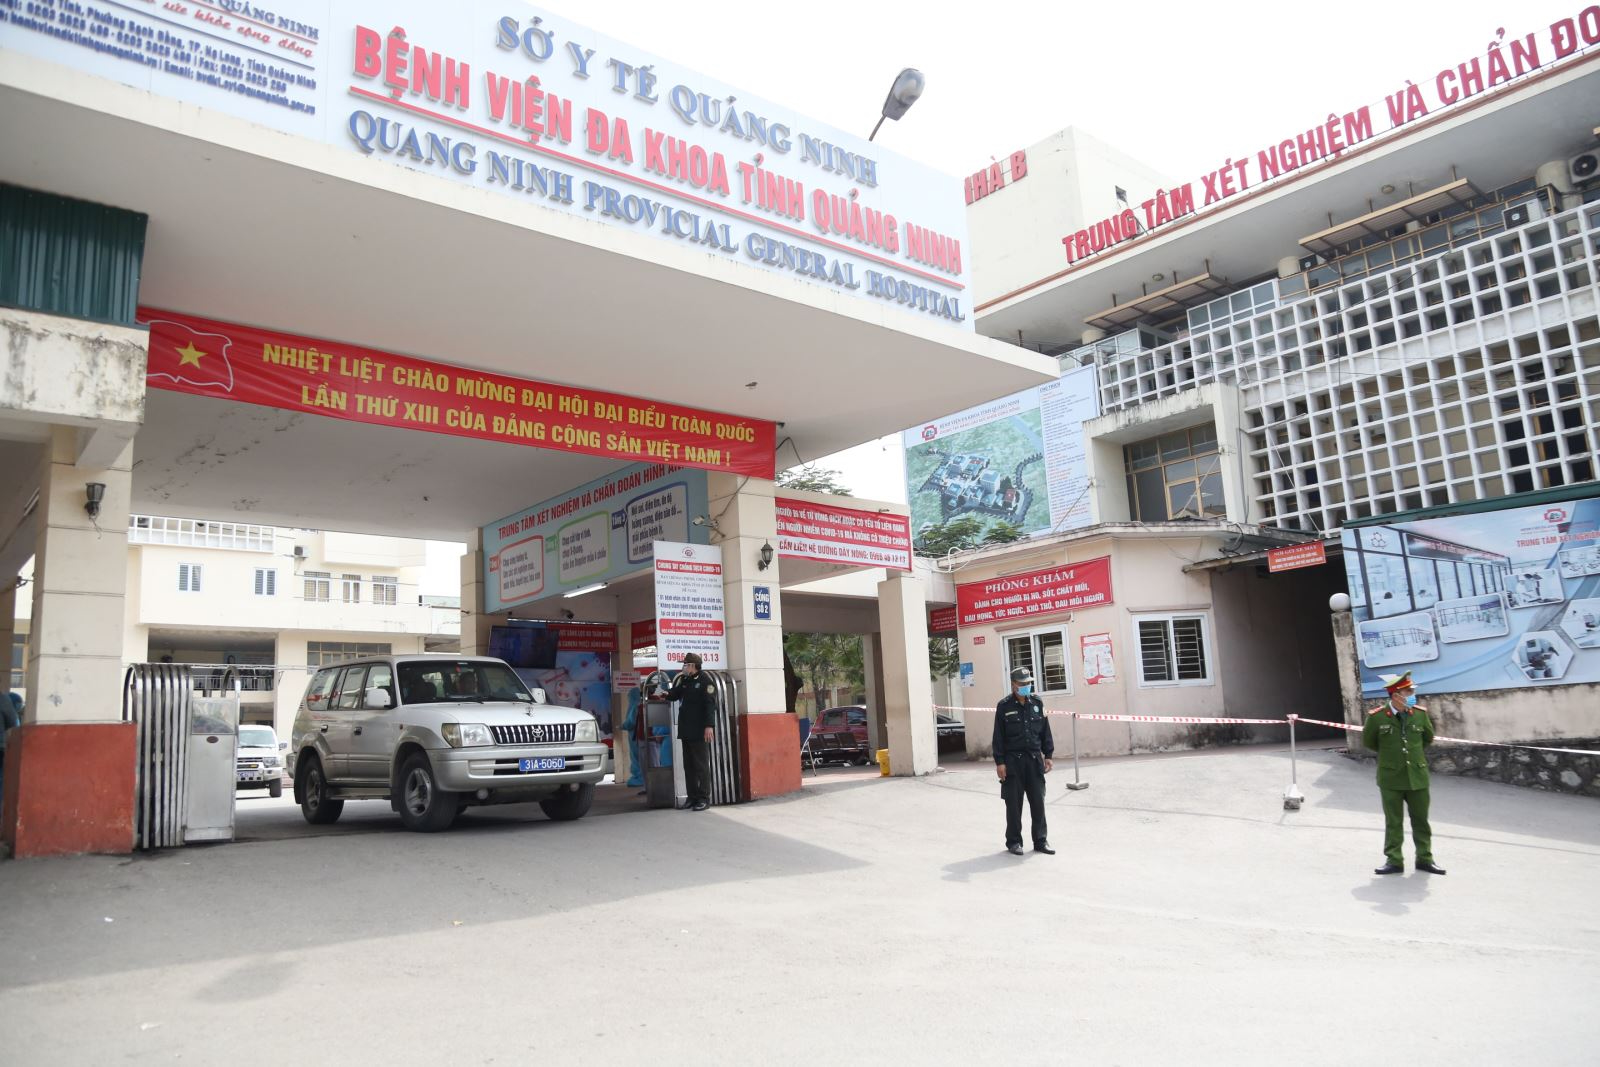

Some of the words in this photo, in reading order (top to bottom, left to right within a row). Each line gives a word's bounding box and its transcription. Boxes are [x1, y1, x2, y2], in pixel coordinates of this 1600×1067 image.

[278, 17, 319, 39] NINH
[496, 15, 554, 62] SỞ
[566, 40, 596, 79] Y
[607, 56, 660, 105] TẾ
[670, 84, 792, 153] QUẢNG
[799, 132, 879, 188] NINH
[353, 24, 470, 111] BỆNH
[485, 71, 572, 145] VIỆN
[585, 107, 634, 165] ĐA
[644, 127, 730, 197] KHOA
[737, 153, 805, 221] TỈNH
[811, 187, 899, 254] QUẢNG
[905, 221, 962, 276] NINH
[1010, 149, 1028, 182] B
[1061, 207, 1139, 265] TRUNG
[1141, 188, 1195, 231] TÂM
[1201, 157, 1250, 207] XÉT
[1257, 105, 1373, 182] NGHIỆM
[1384, 79, 1429, 129] VÀ
[1436, 26, 1541, 106] CHẨN
[349, 109, 478, 175] QUANG
[486, 150, 574, 206] NINH
[582, 179, 739, 254] PROVICIAL
[745, 232, 861, 290] GENERAL
[865, 269, 966, 323] HOSPITAL
[262, 342, 334, 375] NHIỆT
[340, 356, 386, 385] LIỆT
[392, 365, 449, 394] CHÀO
[455, 375, 516, 403] MỪNG
[522, 388, 553, 414] ĐẠI
[558, 393, 589, 420] HỘI
[593, 400, 623, 425] ĐẠI
[628, 405, 666, 429] BIỂU
[671, 414, 712, 436] TOÀN
[715, 418, 755, 443] QUỐC
[301, 382, 348, 411] LẦN
[354, 393, 400, 418] THỨ
[403, 402, 439, 425] XIII
[445, 405, 487, 432] CỦA
[492, 412, 546, 441] ĐẢNG
[551, 423, 602, 450] CỘNG
[606, 431, 642, 456] SẢN
[645, 439, 681, 461] VIỆT
[684, 445, 721, 466] NAM
[498, 522, 519, 540] TRUNG
[521, 516, 535, 530] TÂM
[551, 497, 580, 517] NGHIỆM
[581, 493, 592, 508] VÀ
[593, 479, 616, 504] CHẨN
[617, 473, 641, 494] ĐOÁN
[643, 466, 665, 485] HÌNH
[1516, 538, 1540, 548] TRUNG
[1542, 535, 1558, 545] TÂM
[974, 600, 990, 609] DÀNH
[991, 598, 1003, 607] CHO
[984, 577, 1029, 594] PHÒNG
[1033, 569, 1075, 586] KHÁM
